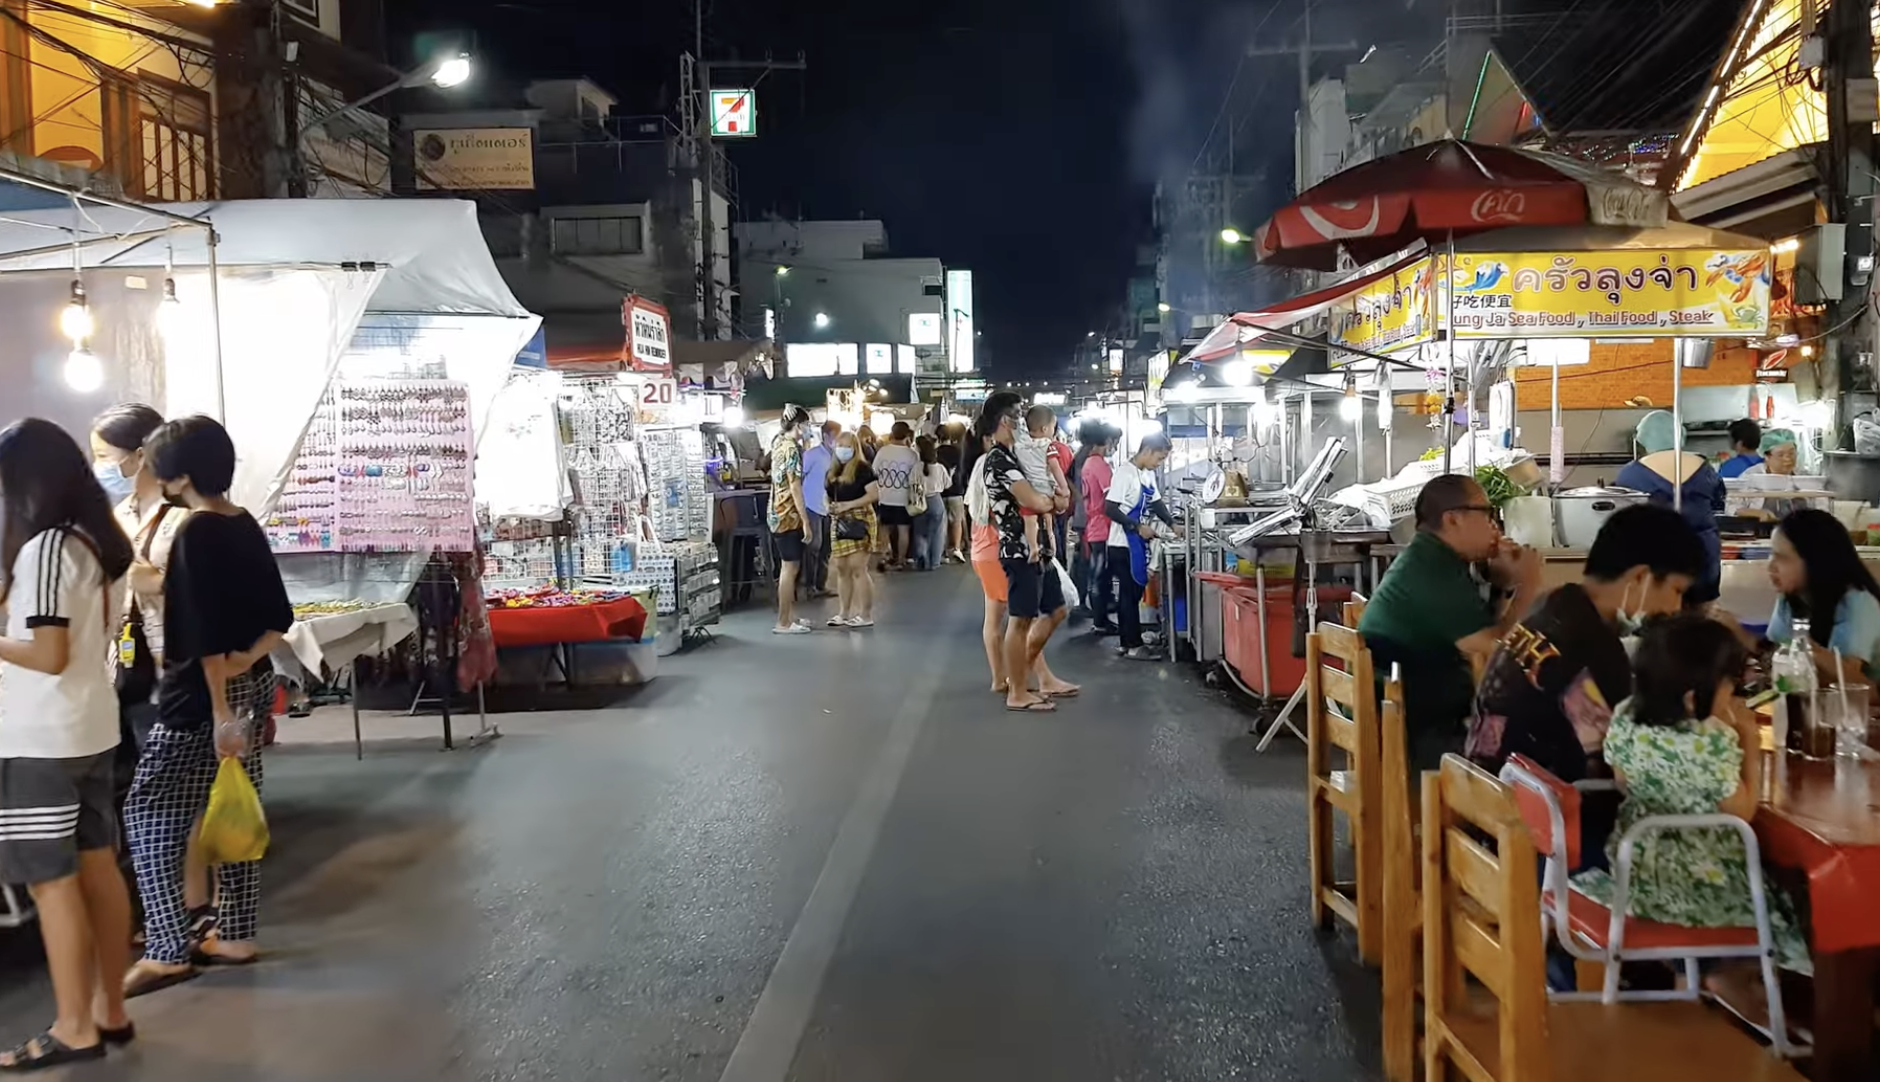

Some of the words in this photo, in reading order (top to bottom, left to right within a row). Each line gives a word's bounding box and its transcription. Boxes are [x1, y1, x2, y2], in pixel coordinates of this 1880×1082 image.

[1513, 253, 1698, 306] ครัวลุงจ่า
[1453, 313, 1483, 329] ung
[1508, 311, 1538, 327] Sea
[1538, 311, 1576, 327] Food
[1588, 310, 1620, 326] Thai
[1621, 310, 1657, 325] Food
[1669, 309, 1715, 325] Steak
[643, 383, 672, 403] 20
